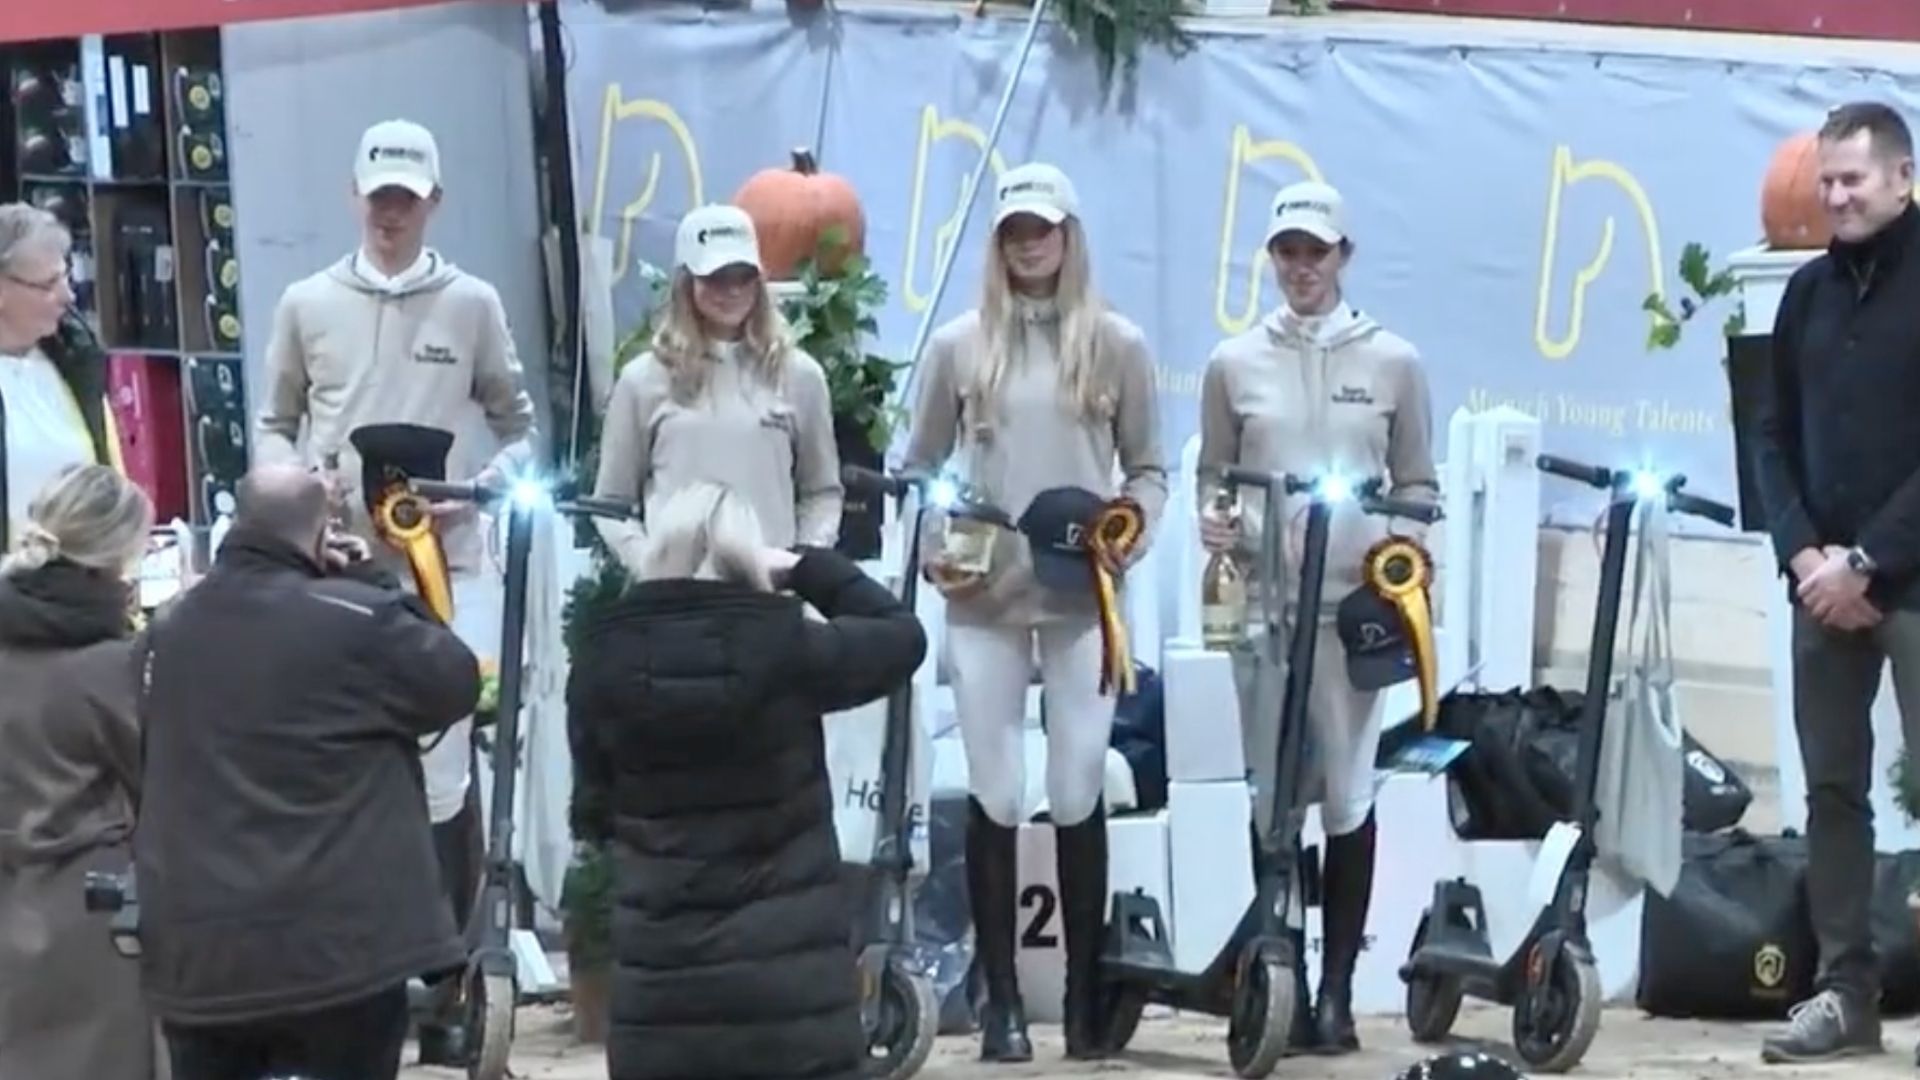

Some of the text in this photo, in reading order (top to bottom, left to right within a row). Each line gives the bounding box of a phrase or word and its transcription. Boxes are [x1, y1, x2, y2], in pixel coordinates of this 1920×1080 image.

[1556, 392, 1626, 436] Young
[1634, 398, 1716, 433] Talents
[1020, 884, 1058, 948] 2
